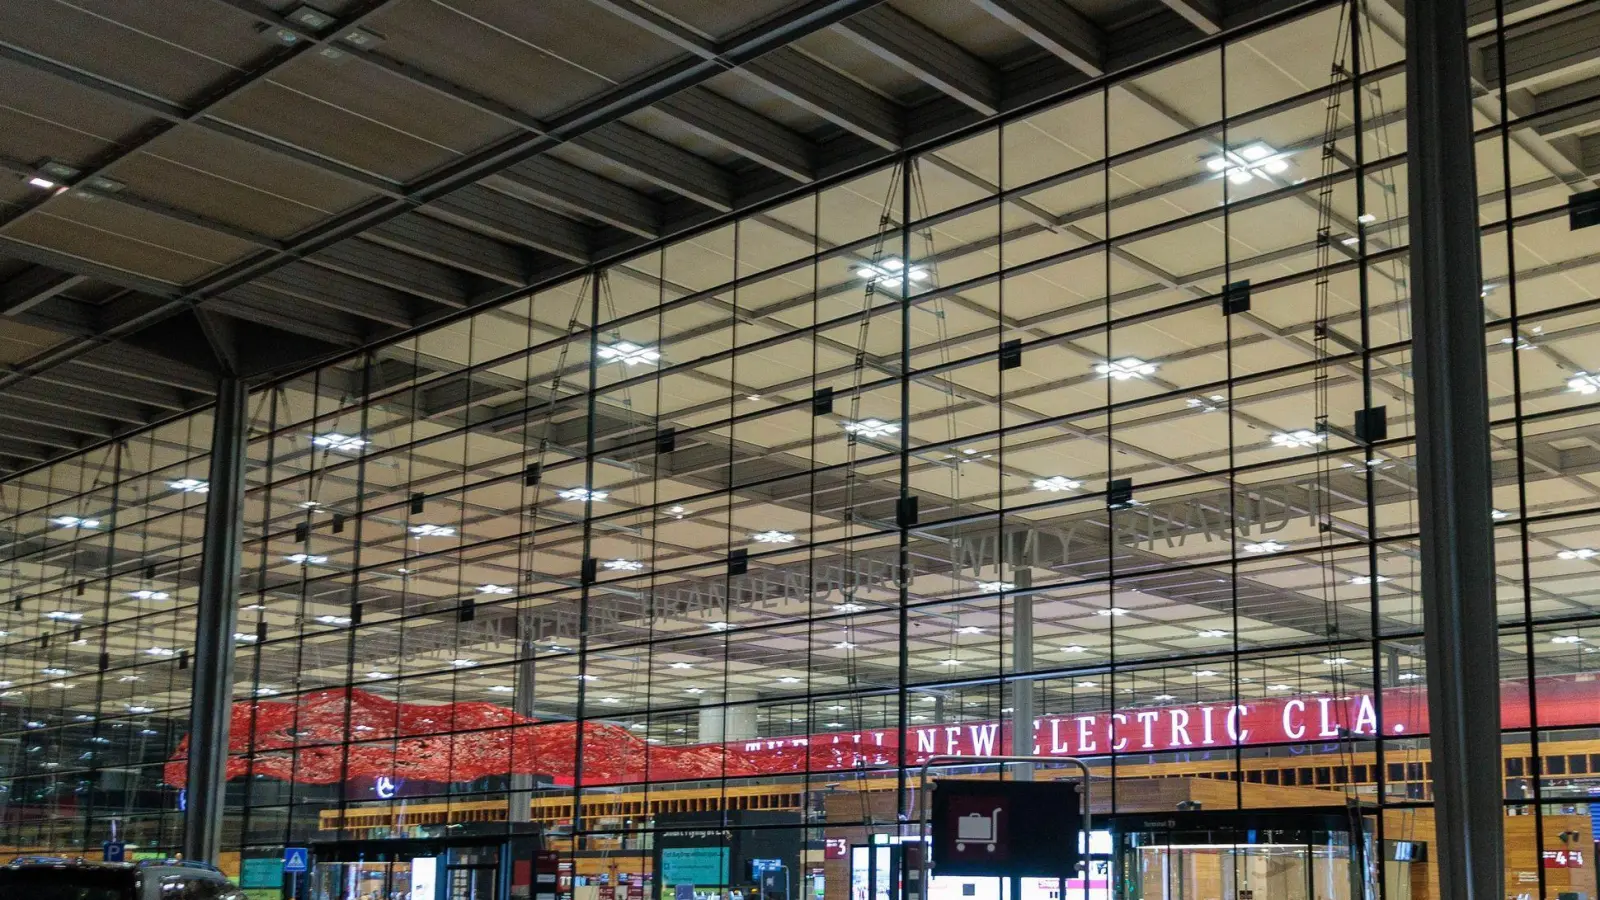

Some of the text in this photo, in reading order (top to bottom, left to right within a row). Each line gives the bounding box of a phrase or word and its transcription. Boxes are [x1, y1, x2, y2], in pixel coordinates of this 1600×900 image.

[916, 723, 999, 763] NEW
[108, 845, 120, 862] P
[837, 838, 847, 856] 3
